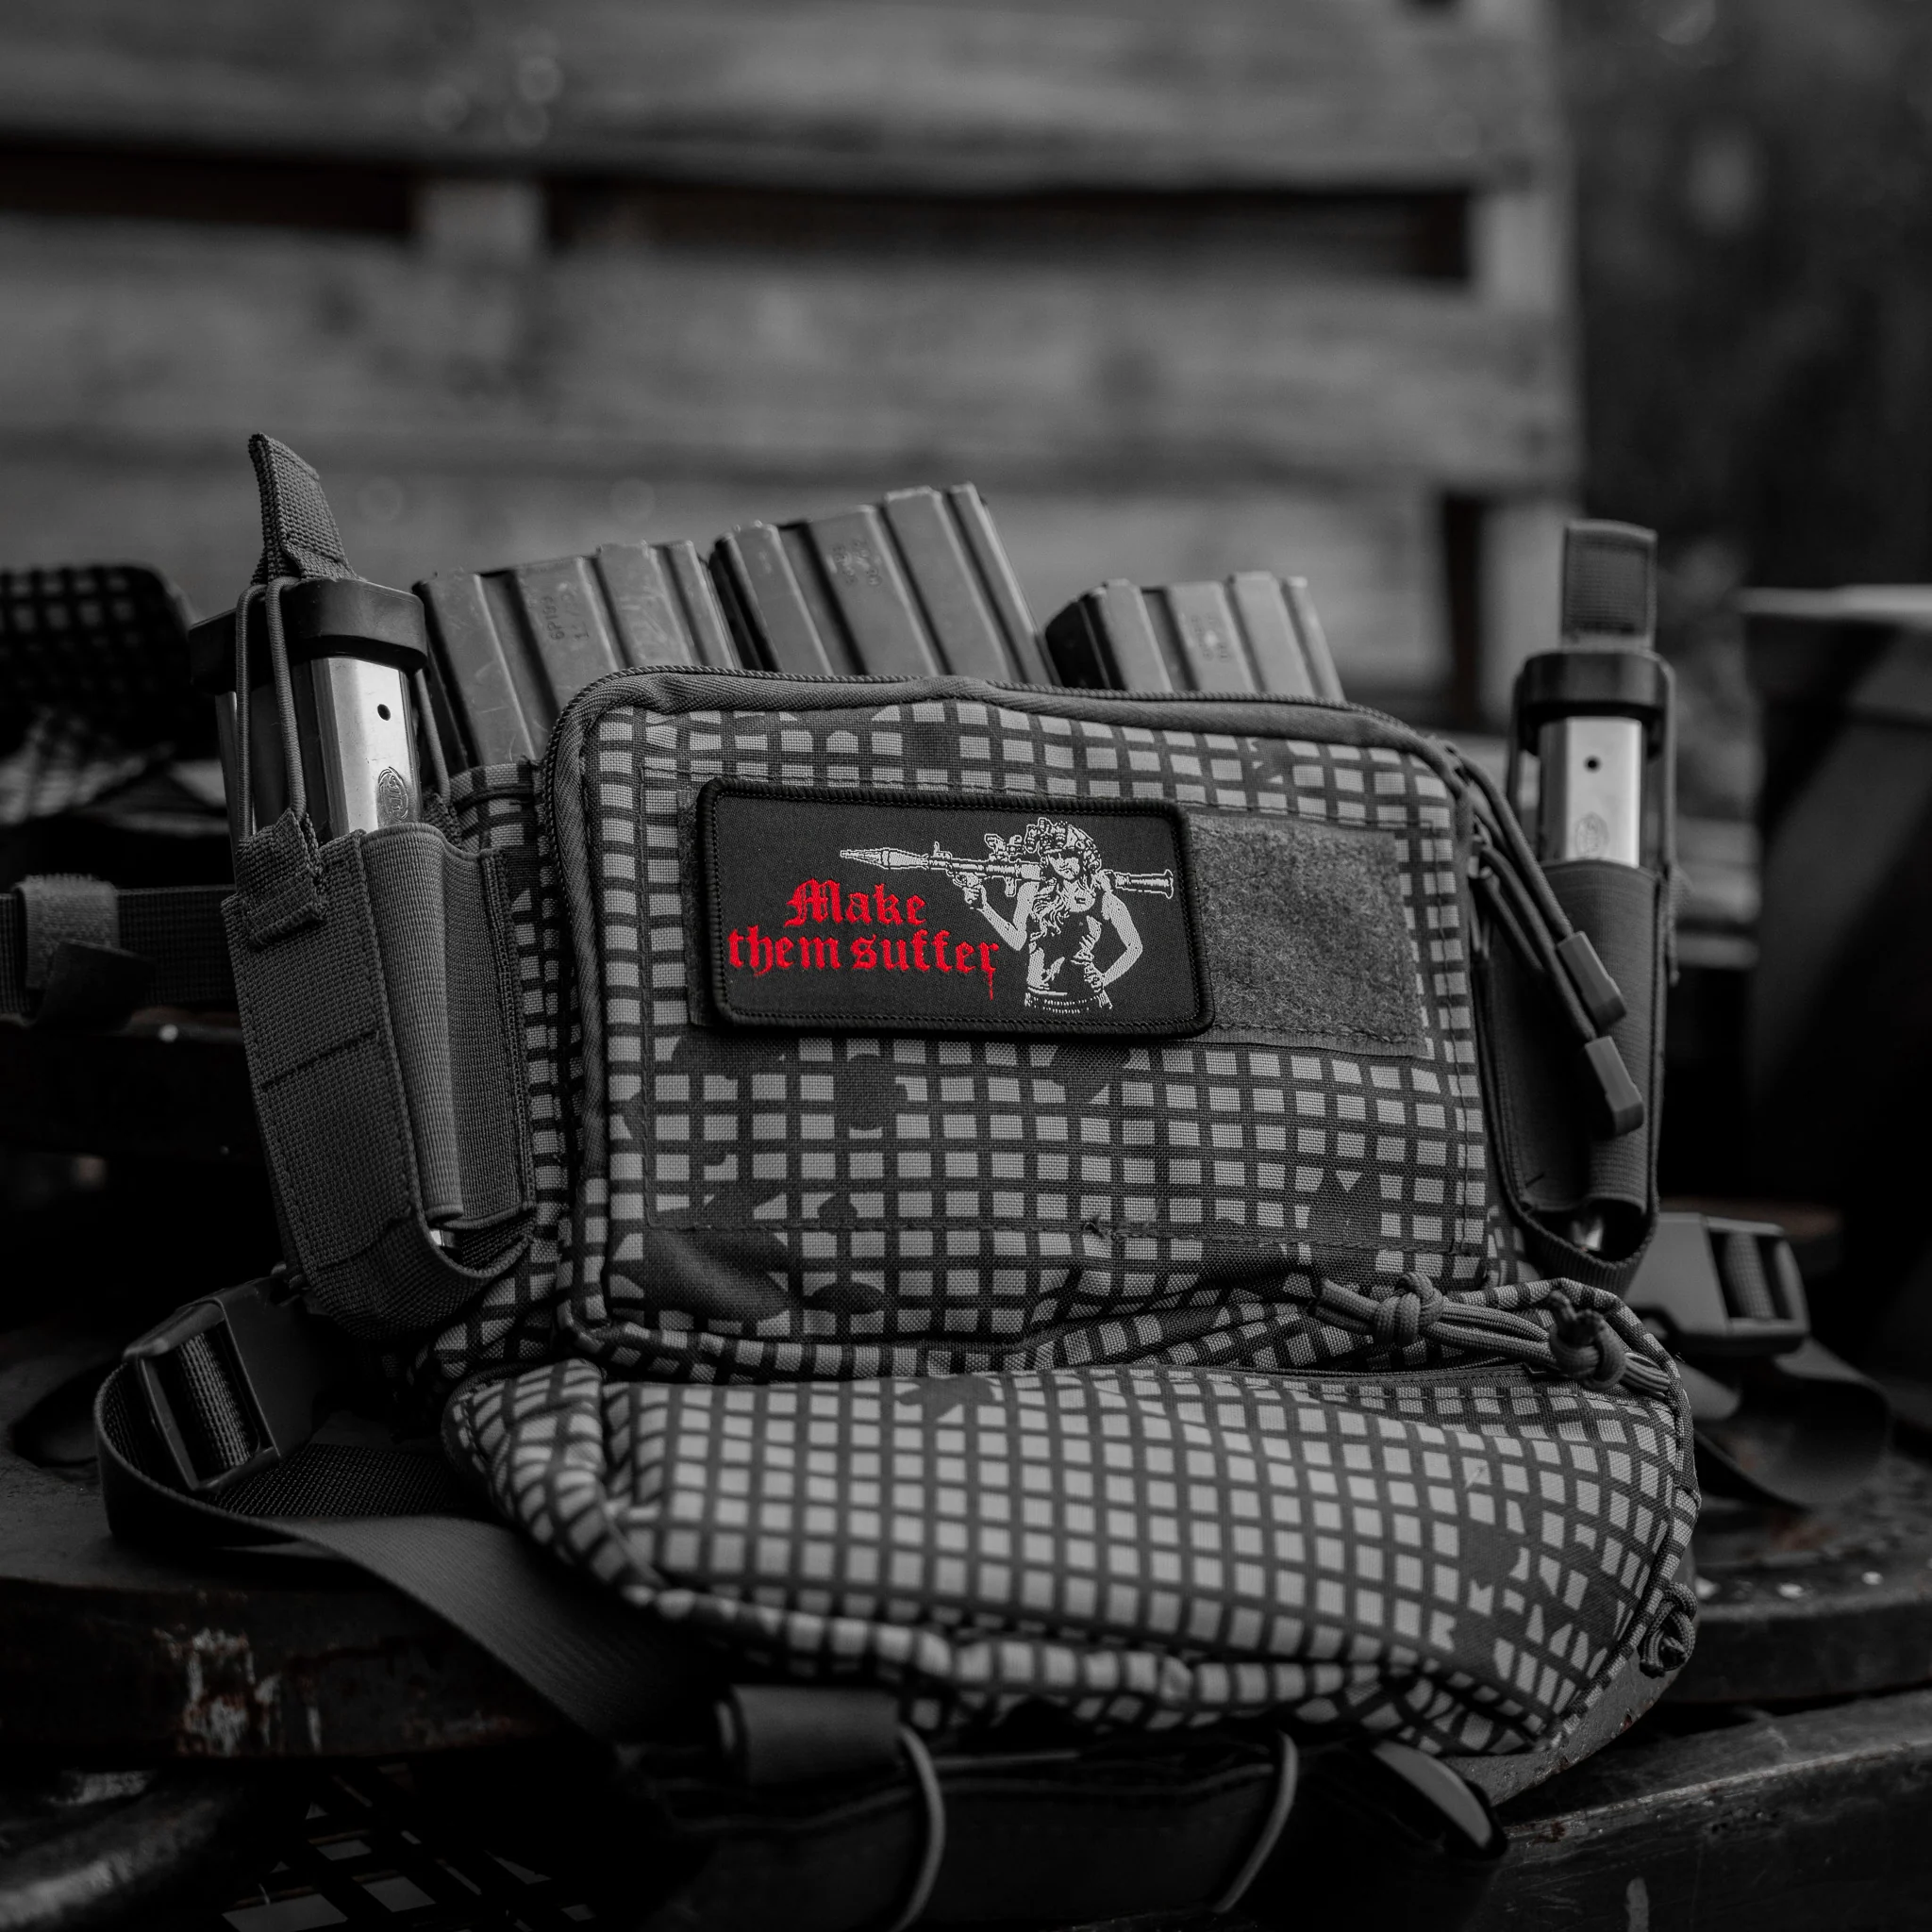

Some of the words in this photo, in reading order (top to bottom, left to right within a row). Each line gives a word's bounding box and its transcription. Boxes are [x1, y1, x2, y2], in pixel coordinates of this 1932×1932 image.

[784, 877, 927, 927] Make
[727, 924, 841, 976] them
[850, 928, 1000, 1001] suffer
